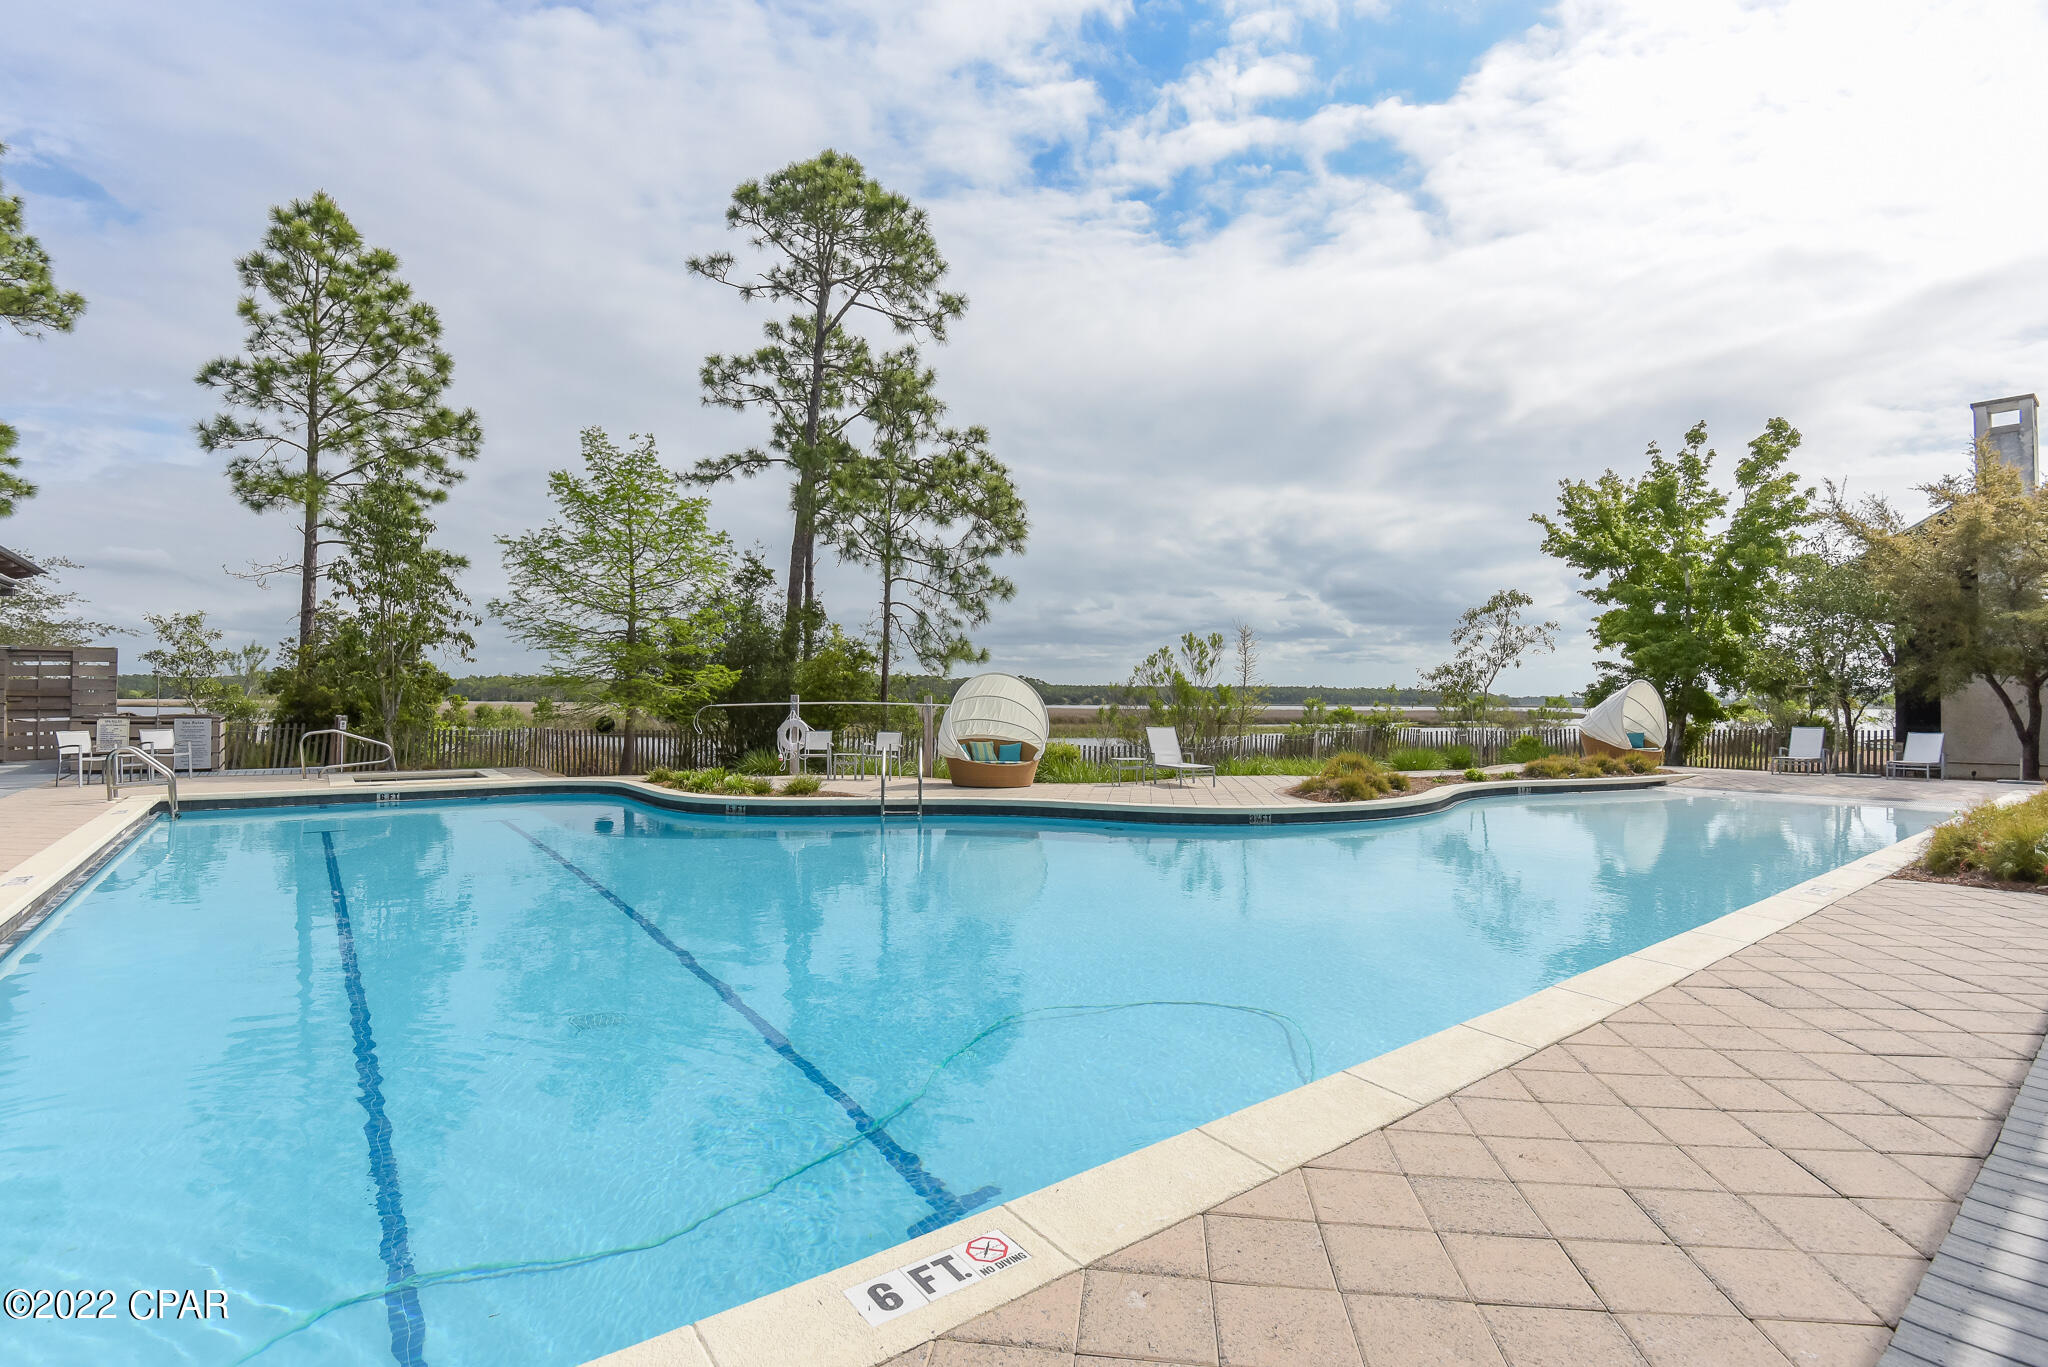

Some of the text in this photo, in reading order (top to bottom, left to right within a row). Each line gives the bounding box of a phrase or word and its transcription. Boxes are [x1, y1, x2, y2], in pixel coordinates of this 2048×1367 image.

[867, 1255, 973, 1311] 6 FT.
[979, 1252, 1027, 1277] NO DIVING
